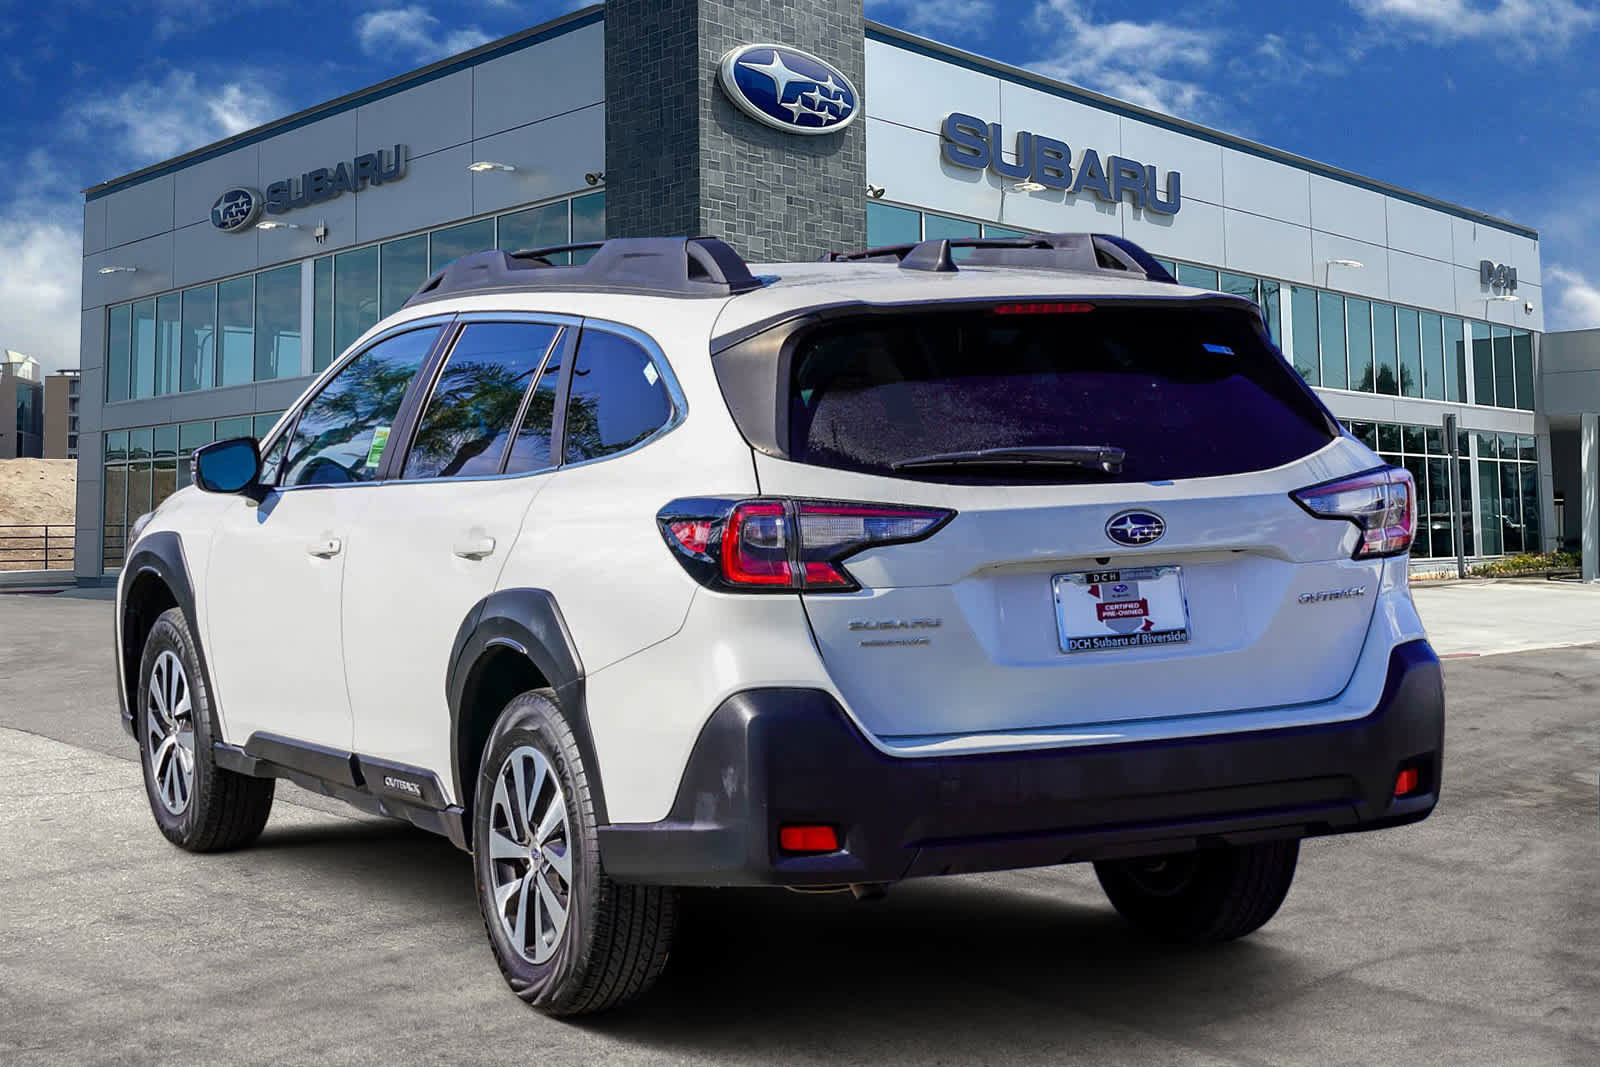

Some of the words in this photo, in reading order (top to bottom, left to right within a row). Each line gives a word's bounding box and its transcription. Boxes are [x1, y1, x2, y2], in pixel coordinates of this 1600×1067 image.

[941, 112, 1181, 215] SUBARU
[266, 144, 404, 215] SUBARU
[1093, 572, 1117, 582] DCH
[1298, 585, 1366, 603] OUTBACK
[1102, 608, 1144, 617] PRE-OWNED
[1104, 602, 1140, 611] CERTIFIED
[1069, 639, 1092, 650] DCH
[1093, 636, 1129, 649] Subaru
[1131, 634, 1140, 645] of
[1142, 631, 1187, 644] Riverside
[384, 776, 421, 796] OUTBACK
